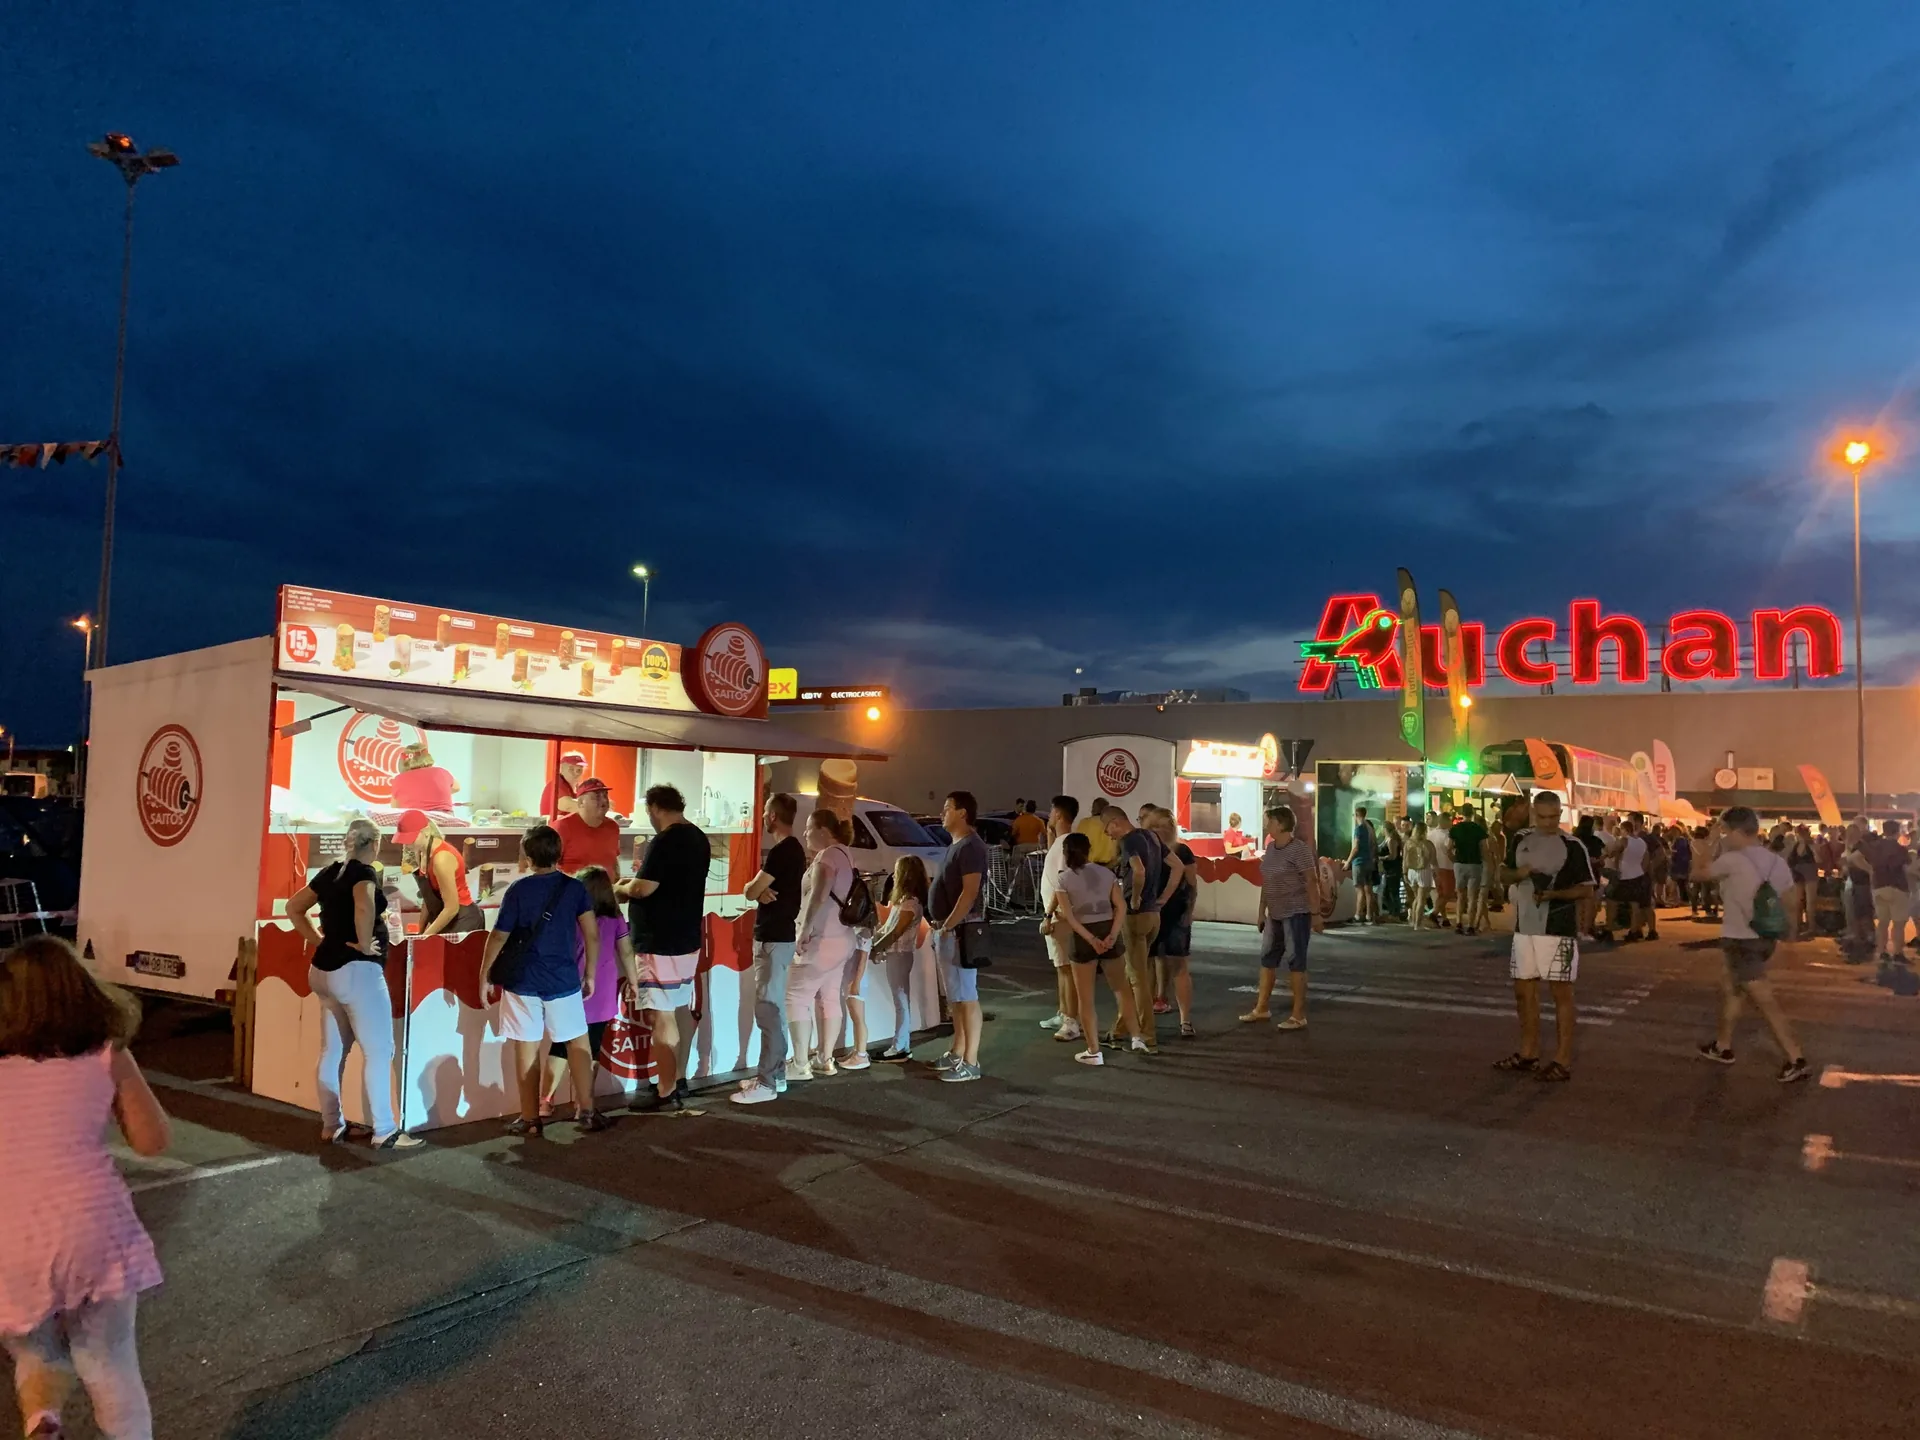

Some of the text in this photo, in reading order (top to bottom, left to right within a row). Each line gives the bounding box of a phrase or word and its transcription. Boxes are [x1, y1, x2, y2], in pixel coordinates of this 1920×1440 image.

[287, 629, 308, 651] 15
[1297, 593, 1844, 692] Auchan
[646, 654, 667, 668] 100%
[714, 688, 748, 701] SAITOS
[359, 775, 393, 786] SAIT
[150, 812, 184, 825] SAITOS
[612, 1035, 654, 1054] SAIT
